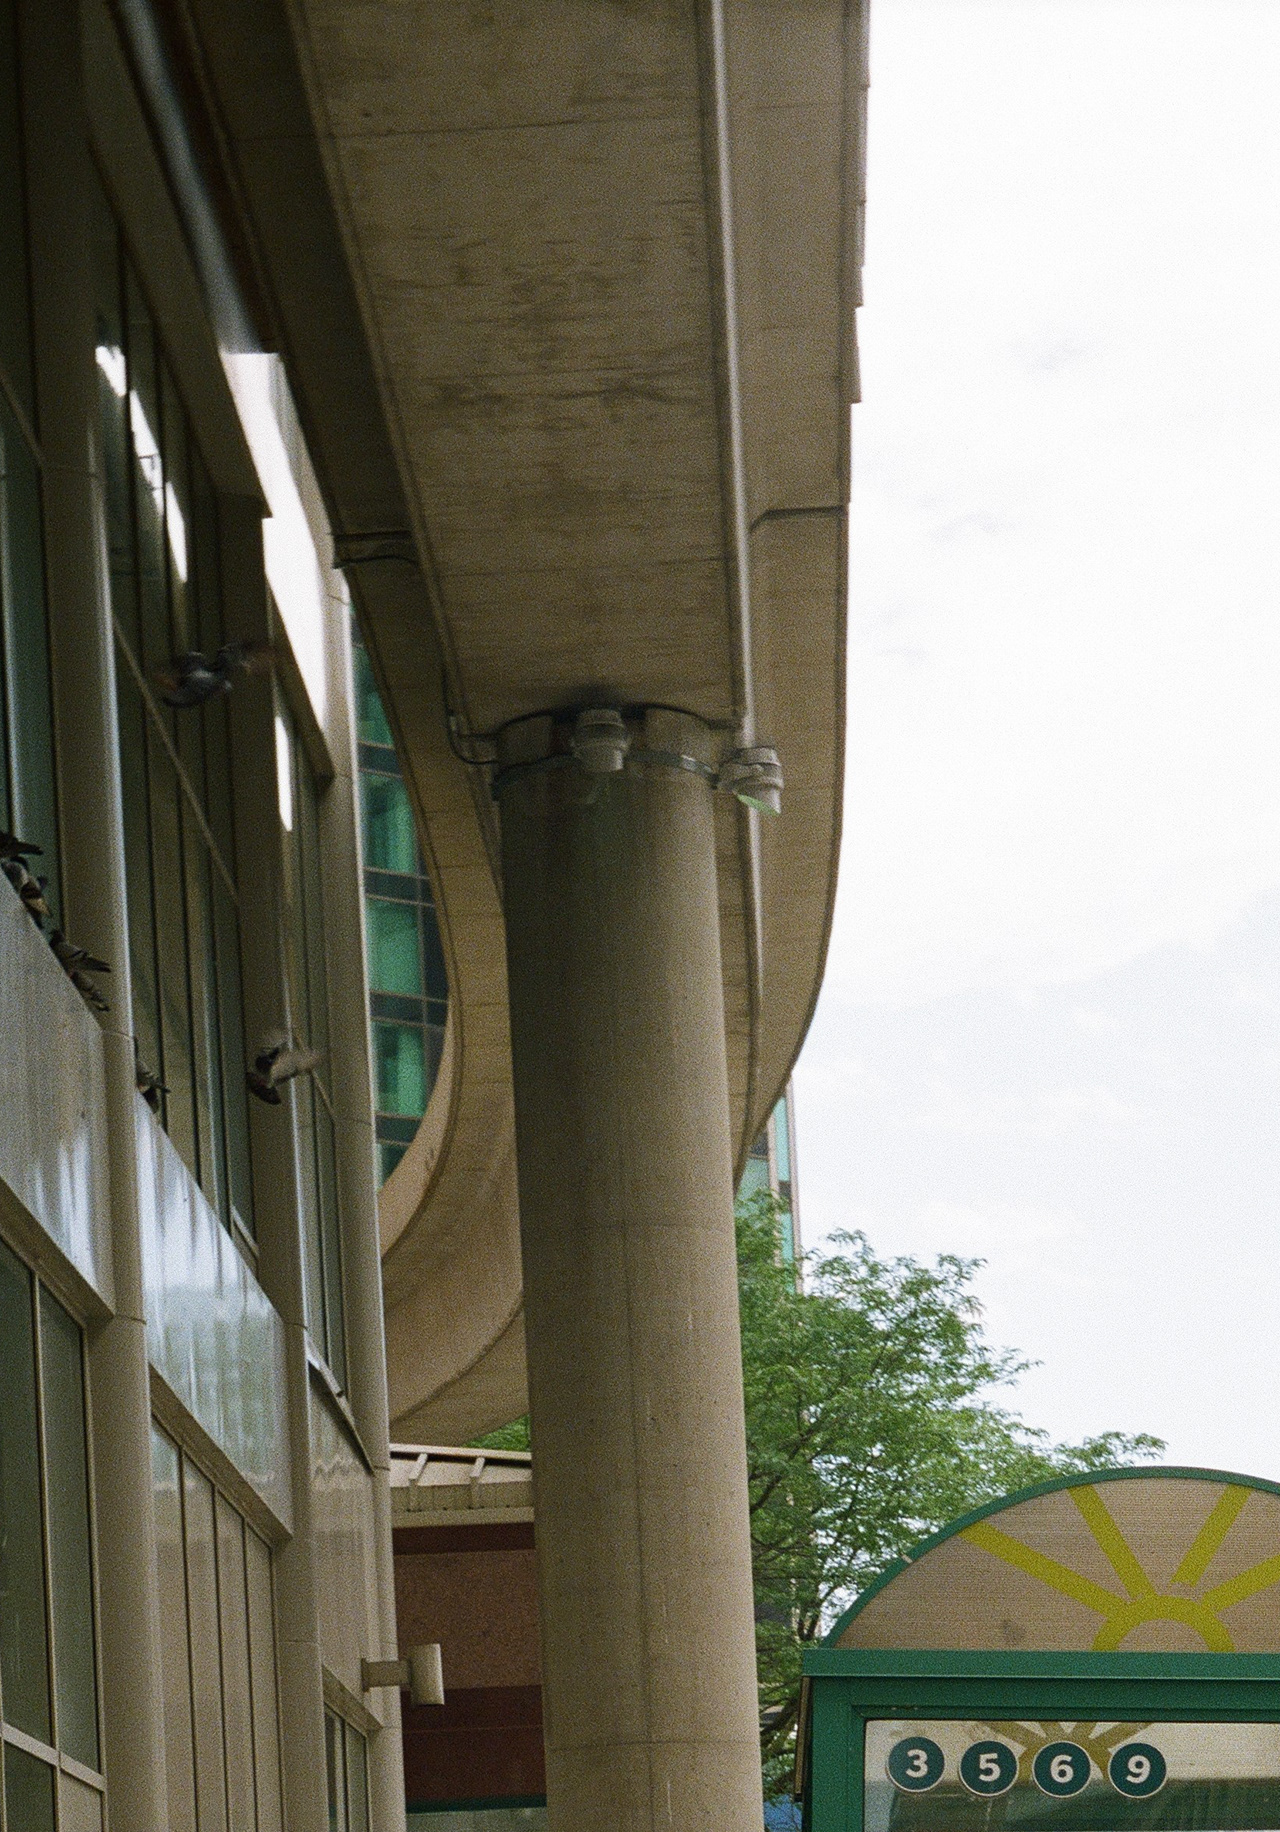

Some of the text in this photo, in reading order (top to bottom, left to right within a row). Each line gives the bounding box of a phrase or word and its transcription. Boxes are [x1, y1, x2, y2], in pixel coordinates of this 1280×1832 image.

[905, 1748, 1151, 1784] 3 5 6 9
